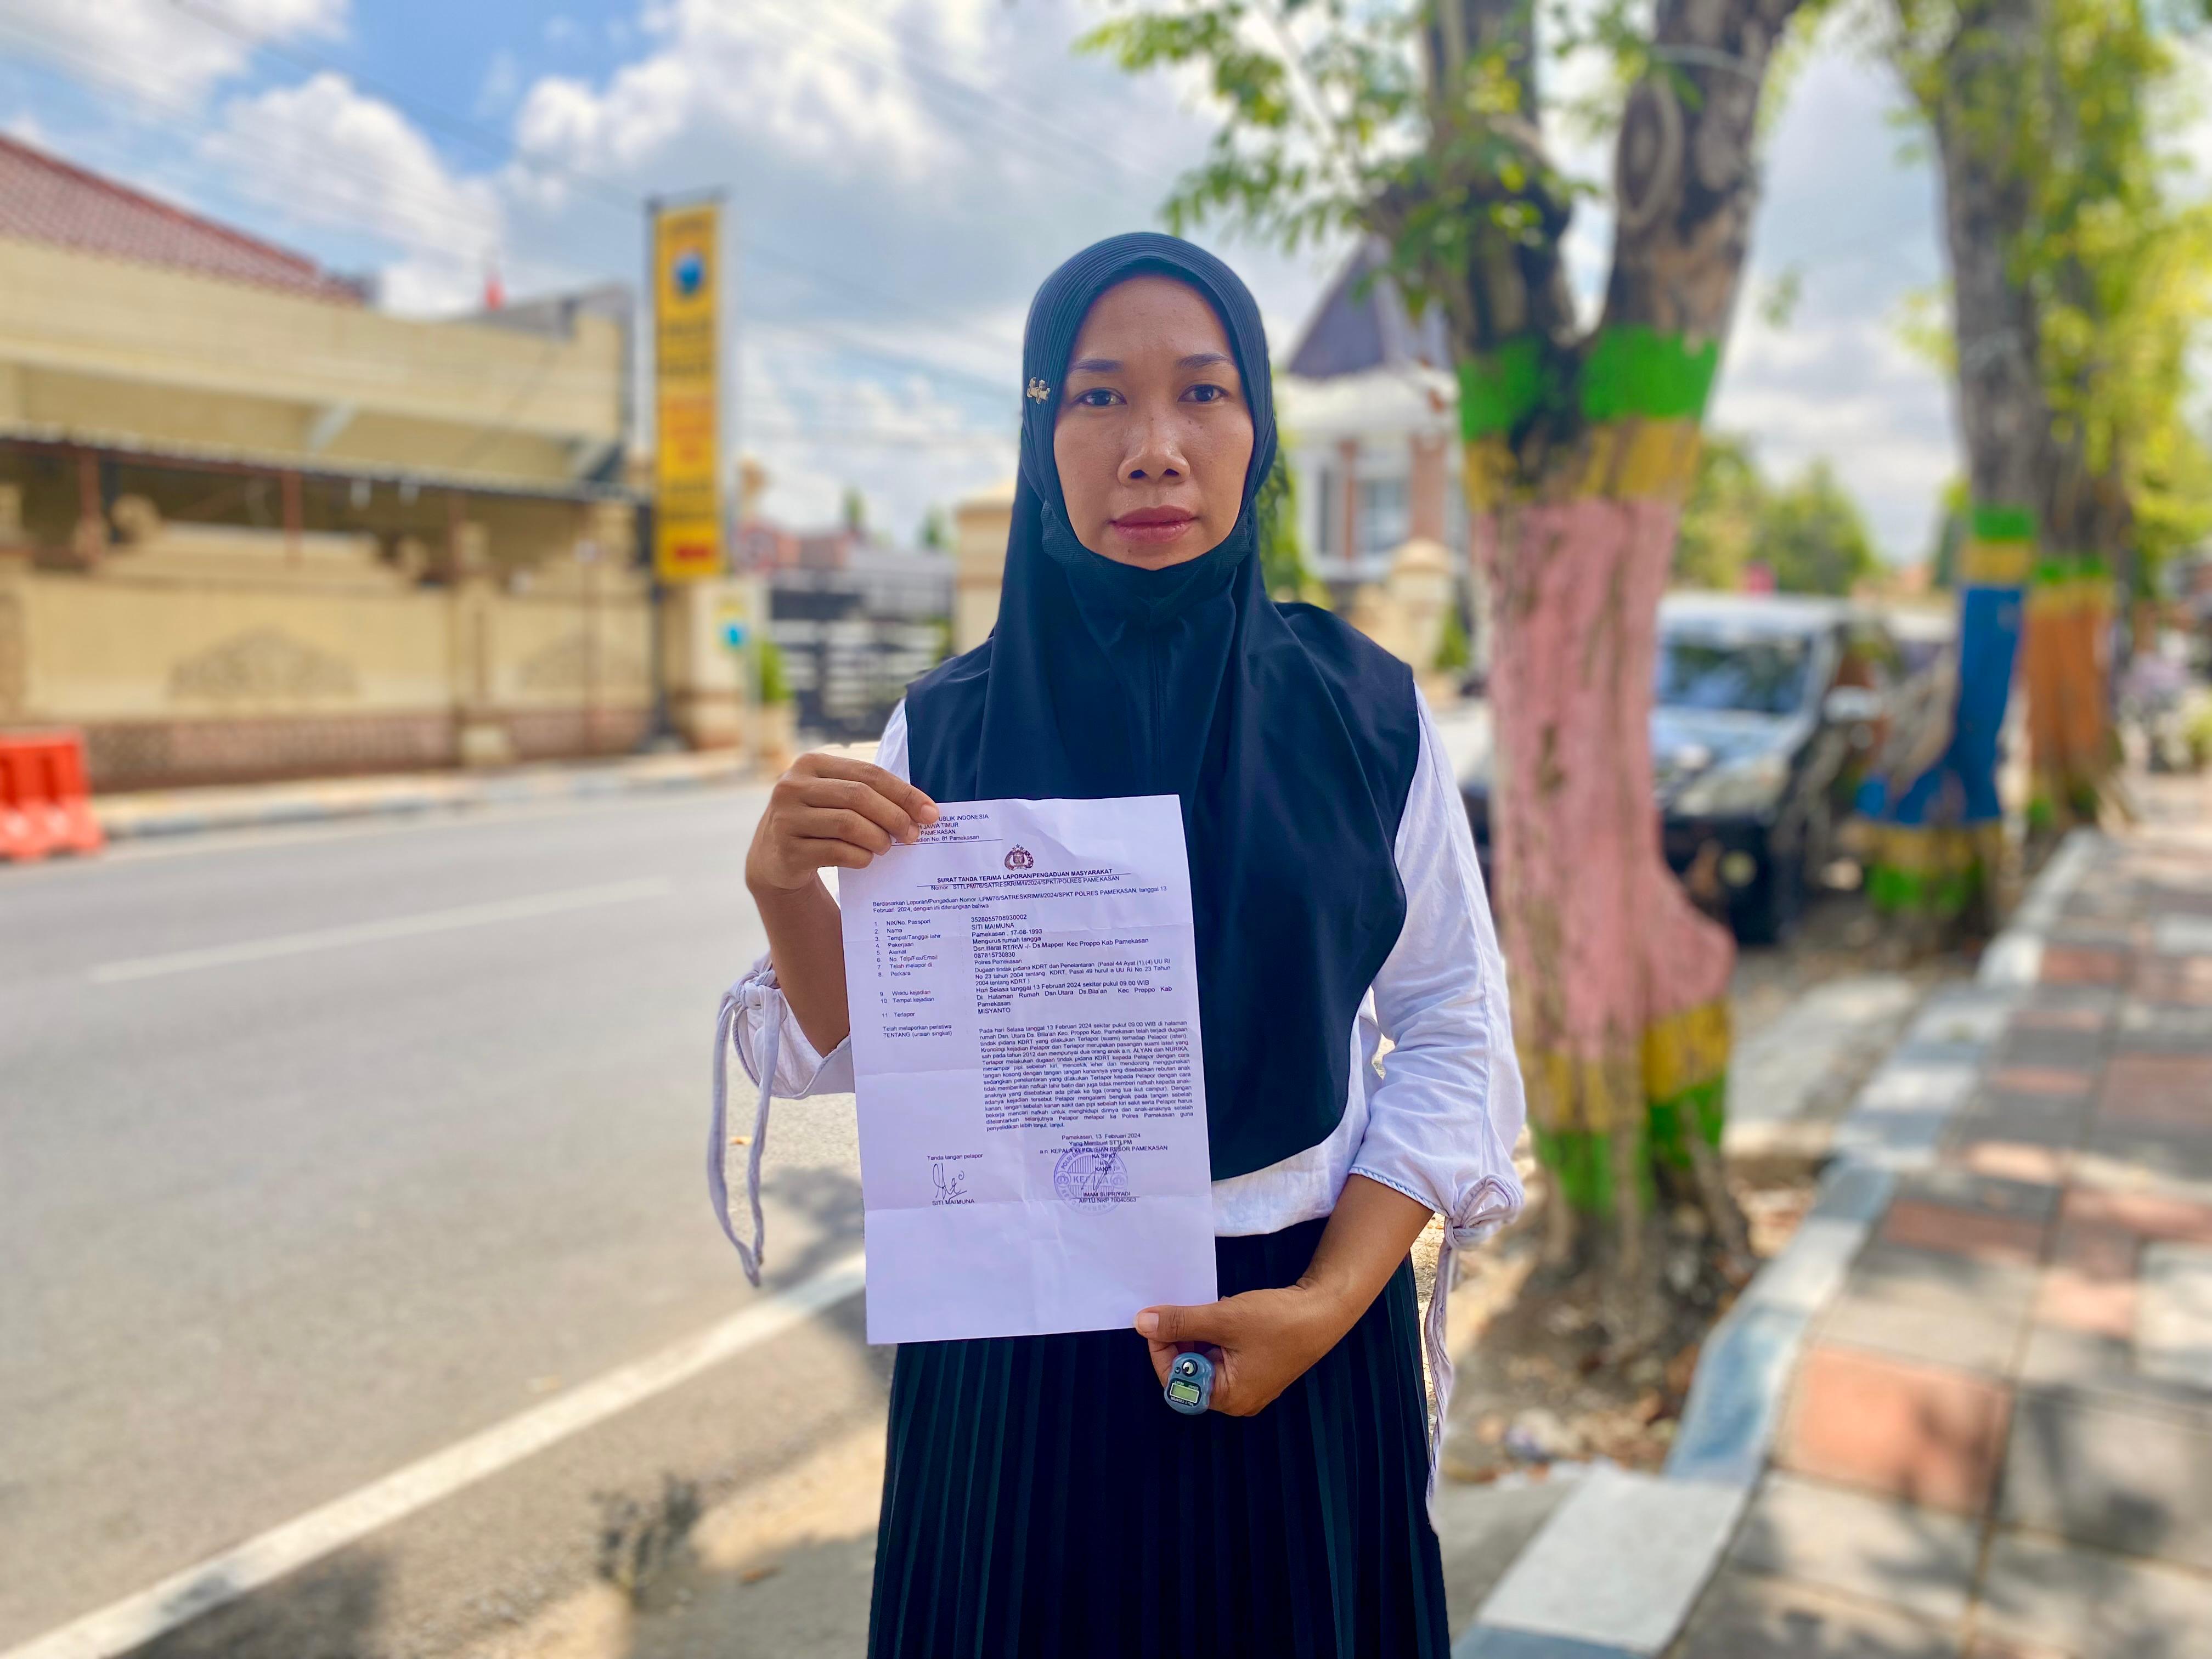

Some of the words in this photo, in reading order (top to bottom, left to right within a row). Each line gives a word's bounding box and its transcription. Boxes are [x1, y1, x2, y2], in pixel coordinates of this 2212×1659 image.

[1002, 871, 1070, 879] LAPORAN/PENGADUAN
[906, 898, 958, 906] Laporan/Pengaduan
[970, 914, 1027, 922] 3528055708930002
